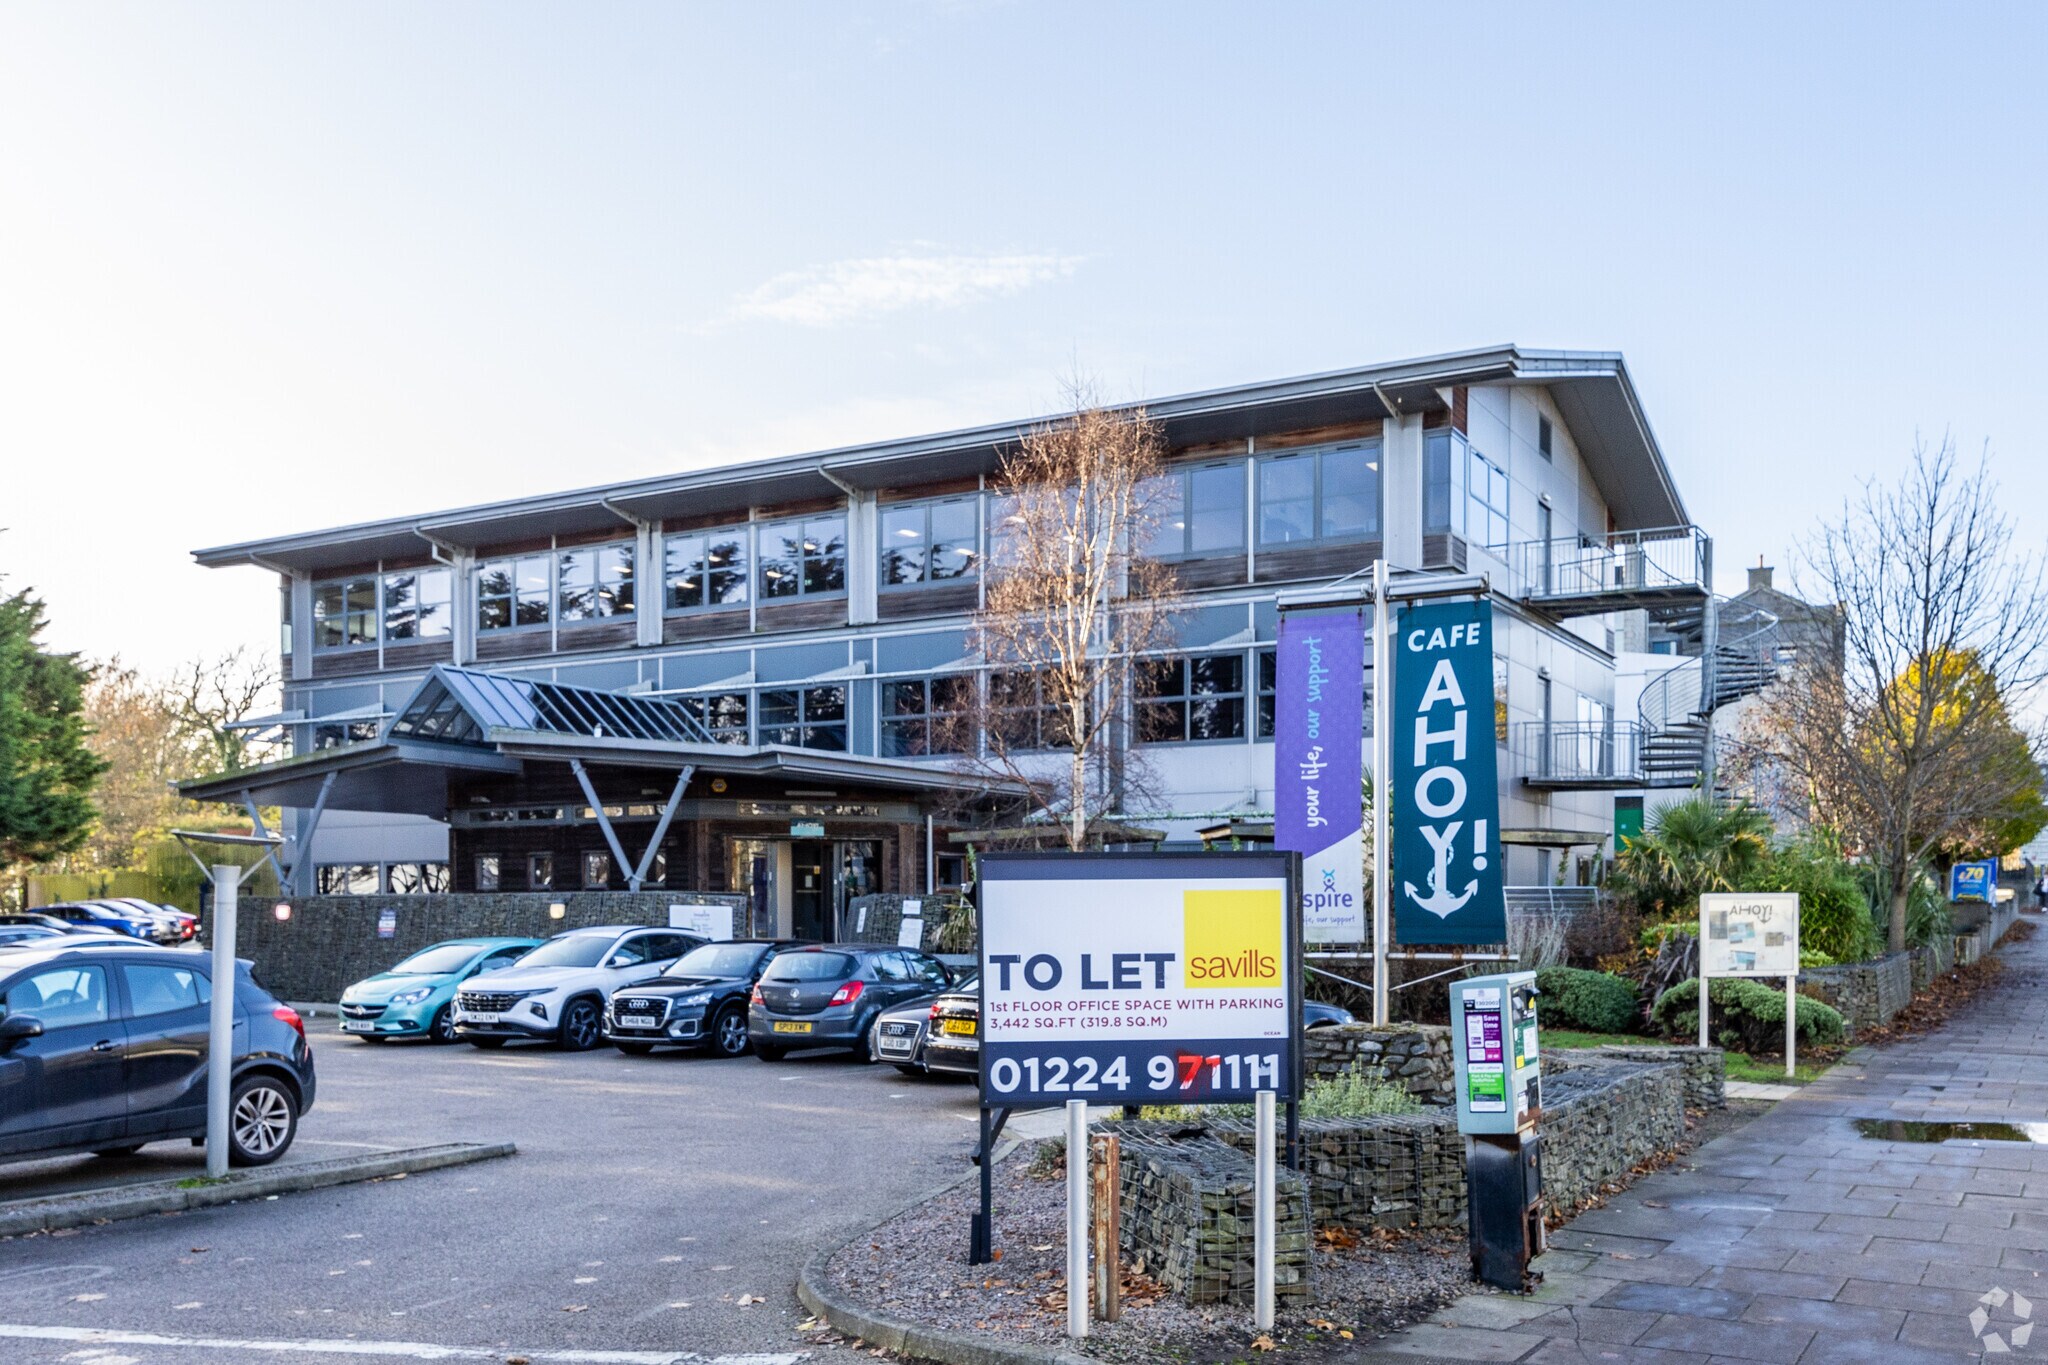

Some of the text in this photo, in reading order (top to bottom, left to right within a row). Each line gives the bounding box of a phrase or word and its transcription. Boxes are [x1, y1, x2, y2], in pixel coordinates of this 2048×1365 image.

[1407, 622, 1481, 652] CAFE
[1300, 636, 1329, 828] your life, our support
[1405, 658, 1488, 919] AHOY!
[1303, 893, 1353, 912] spire
[1729, 905, 1773, 924] AHOY!
[989, 952, 1176, 991] TO LET
[1190, 949, 1276, 979] savills
[990, 998, 1284, 1012] 1st FLOOR OFFICE SPACE WITH PARKING
[990, 1016, 1168, 1030] 3,442 SQ.FT (319.8 SQ.M)
[989, 1054, 1279, 1093] 01224 971111
